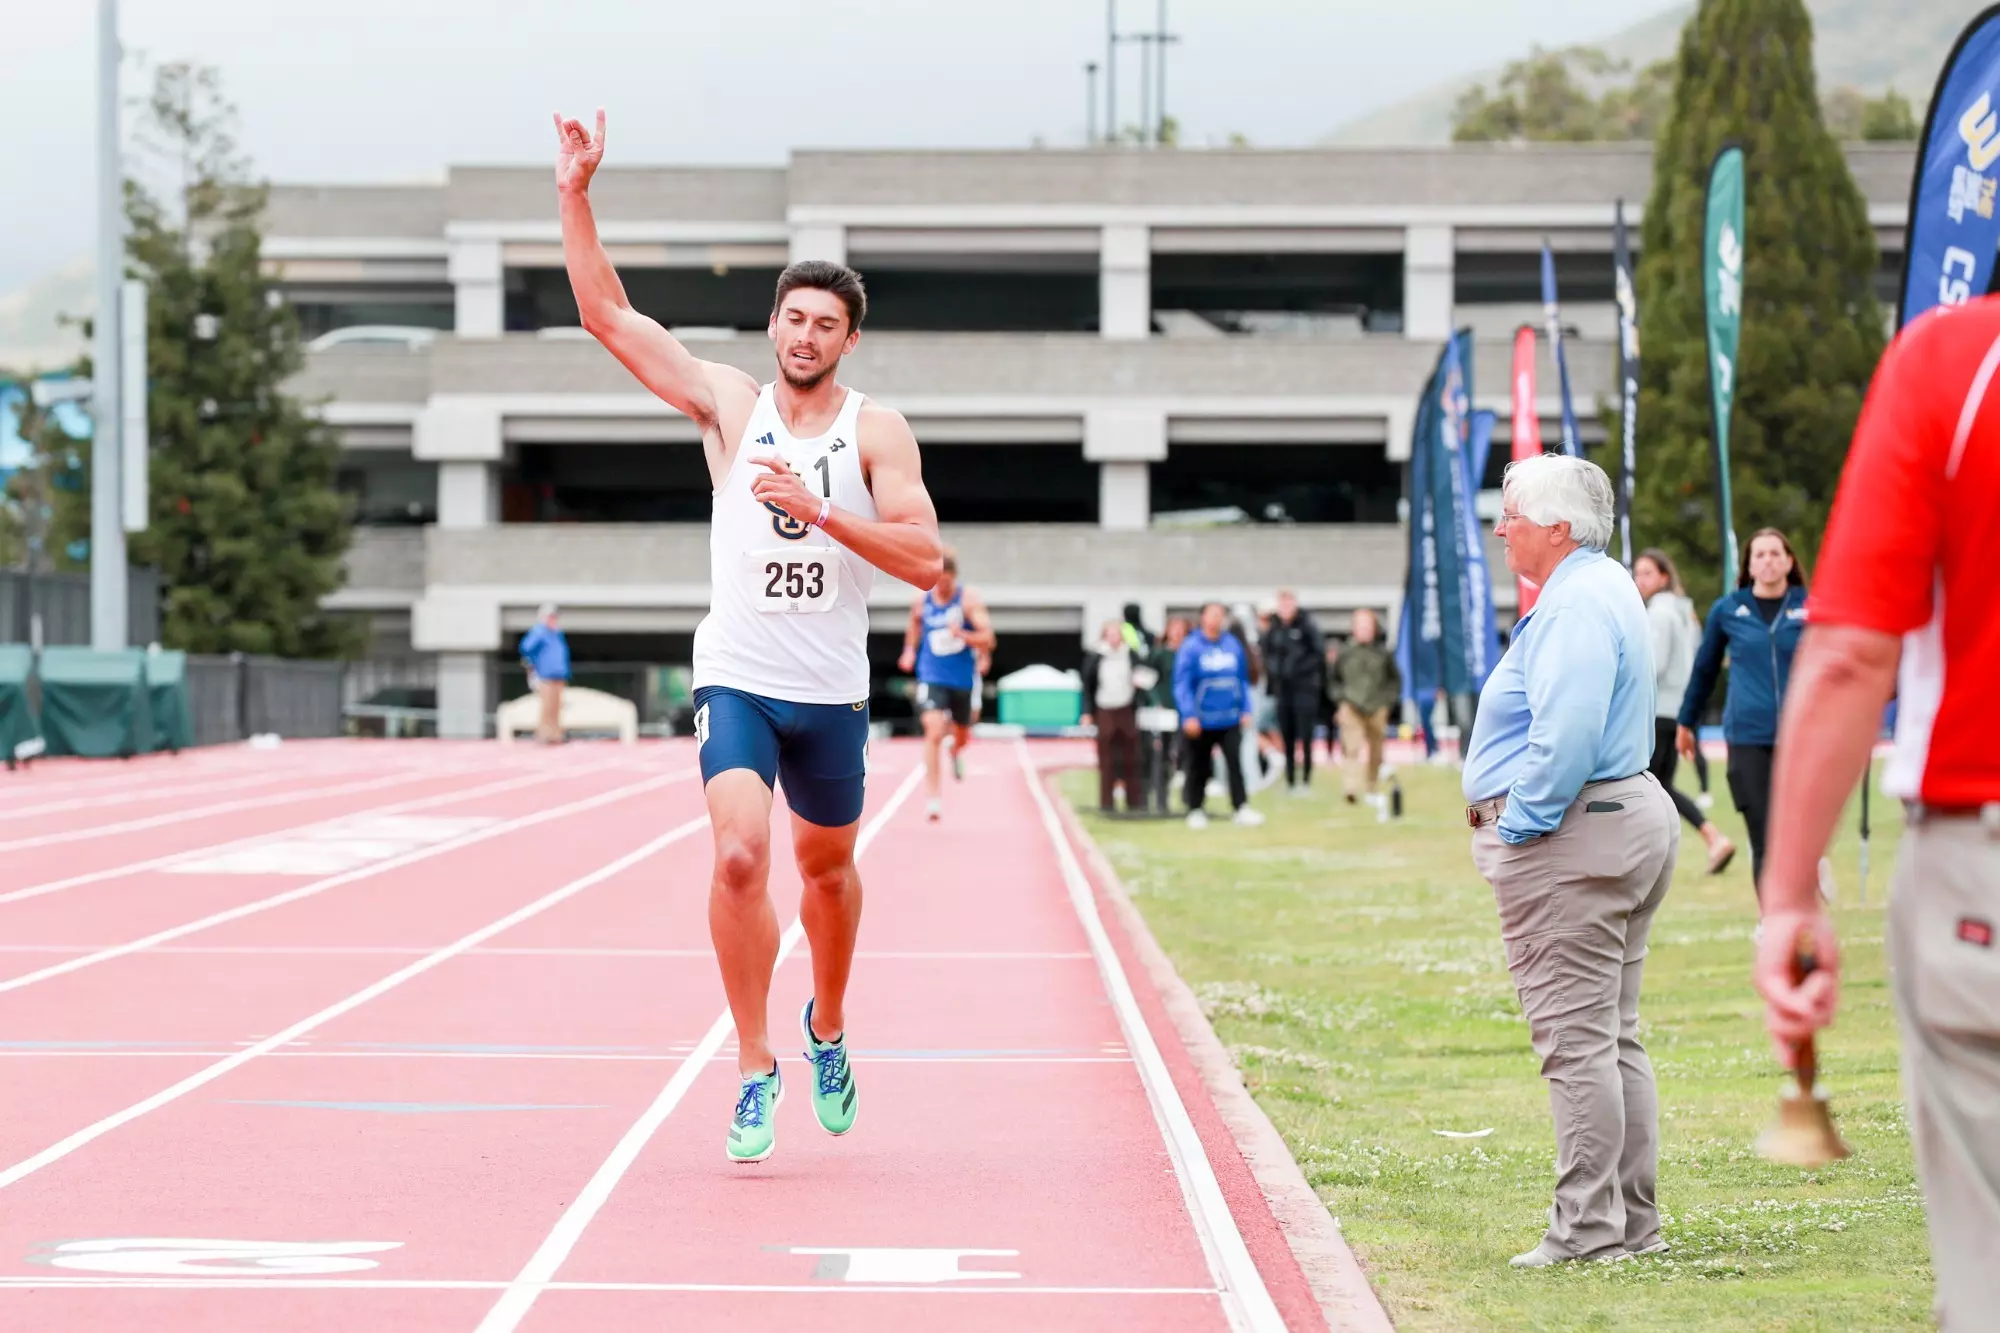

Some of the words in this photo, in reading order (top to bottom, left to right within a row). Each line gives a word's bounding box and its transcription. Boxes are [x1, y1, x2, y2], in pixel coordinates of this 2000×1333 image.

[1936, 246, 1976, 316] CS
[814, 456, 831, 498] 1
[765, 561, 824, 598] 253
